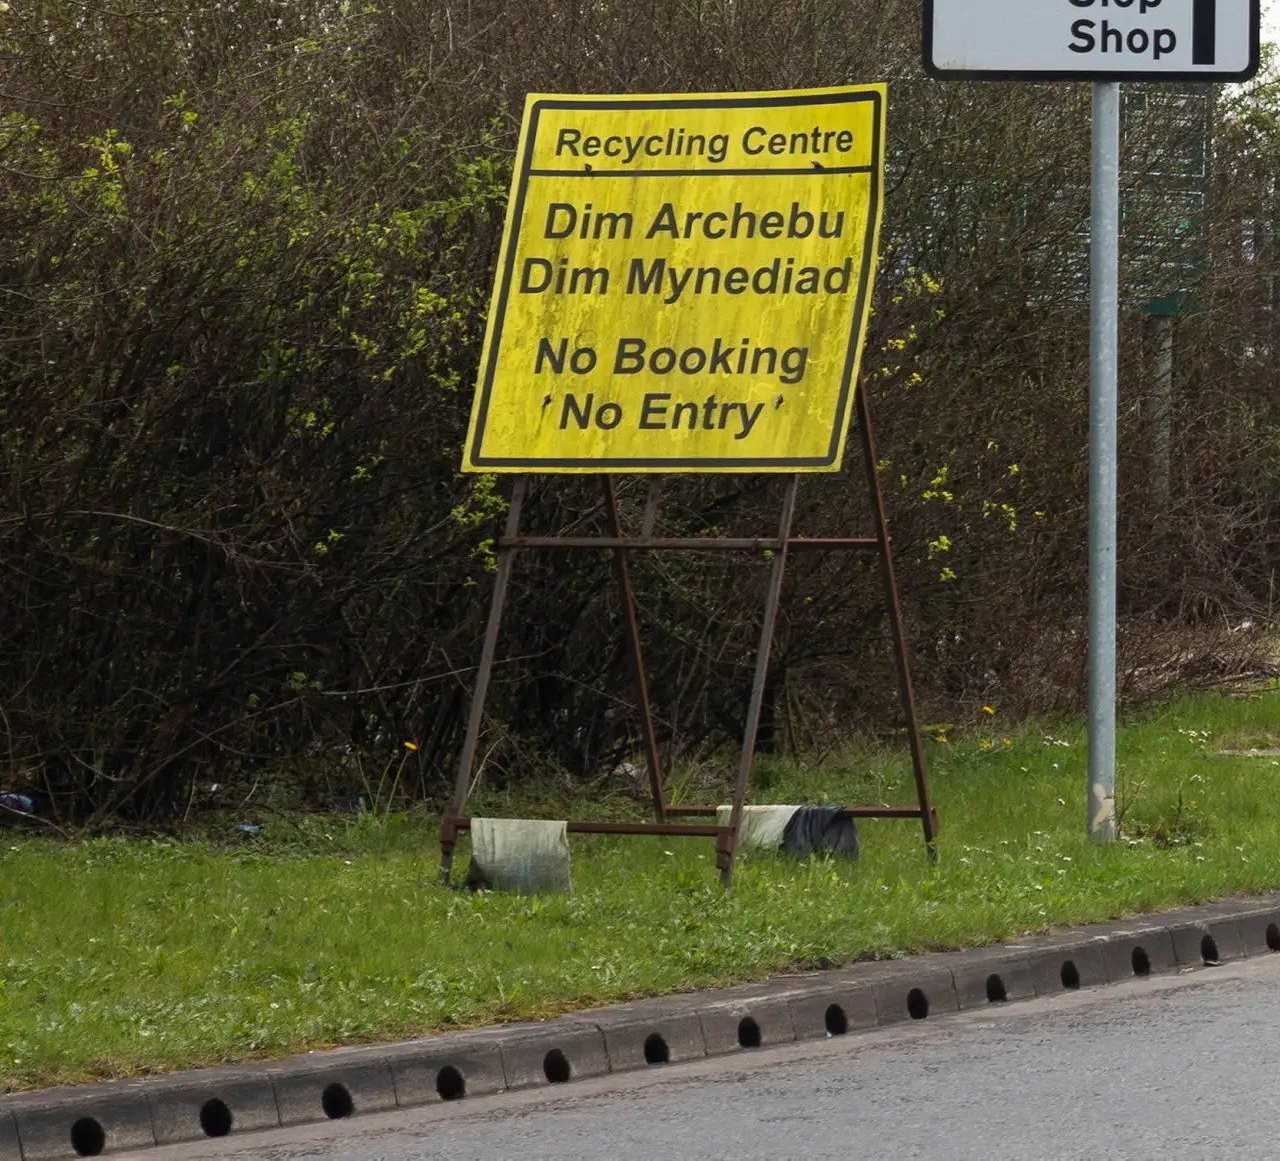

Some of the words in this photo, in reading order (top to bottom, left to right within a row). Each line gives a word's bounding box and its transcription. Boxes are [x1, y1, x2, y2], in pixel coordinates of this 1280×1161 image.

[1067, 19, 1177, 60] Shop
[555, 127, 729, 163] Recycling
[741, 125, 854, 155] Centre
[543, 202, 635, 240] Dim
[646, 202, 845, 239] Archebu
[519, 257, 611, 295] Dim
[626, 257, 853, 304] Mynediad
[534, 337, 598, 375] No
[613, 337, 809, 384] Booking
[559, 393, 623, 431] No
[638, 392, 765, 439] Entry
